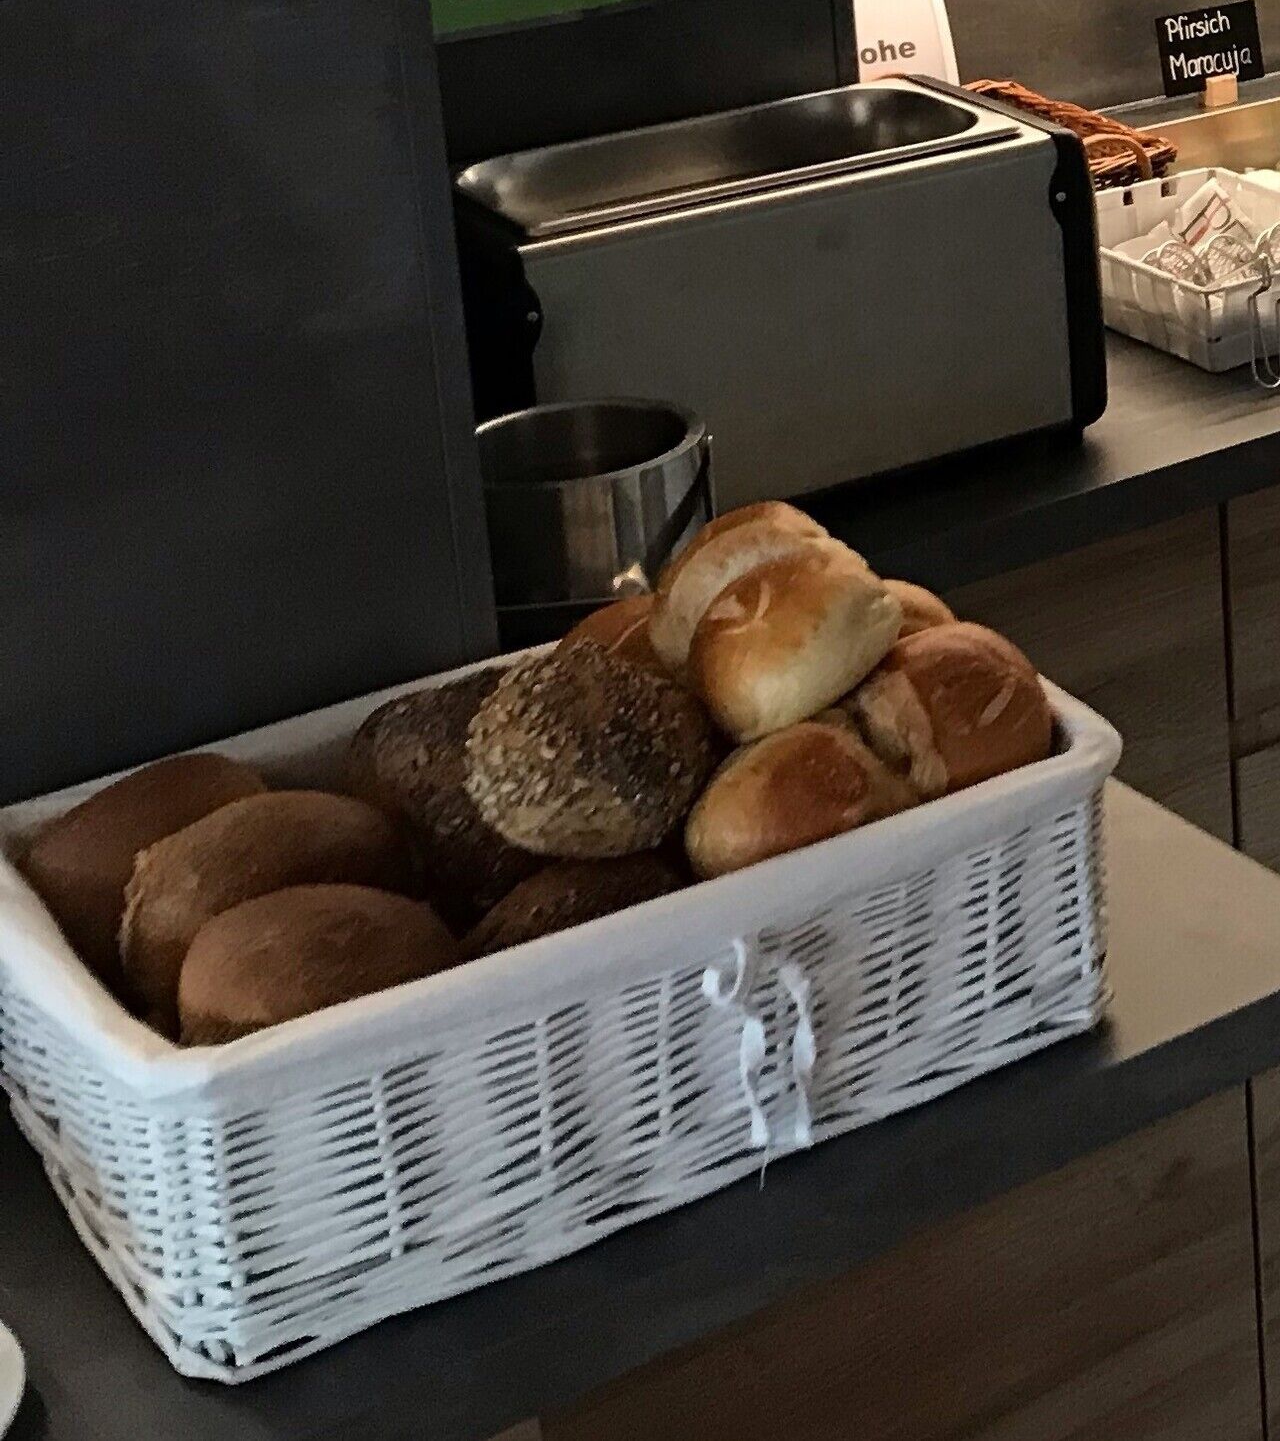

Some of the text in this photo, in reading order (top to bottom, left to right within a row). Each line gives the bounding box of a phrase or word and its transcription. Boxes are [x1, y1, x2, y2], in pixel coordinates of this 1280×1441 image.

[1164, 10, 1231, 43] Pfirsich
[860, 39, 917, 65] ohe
[1169, 44, 1252, 81] Maracuja
